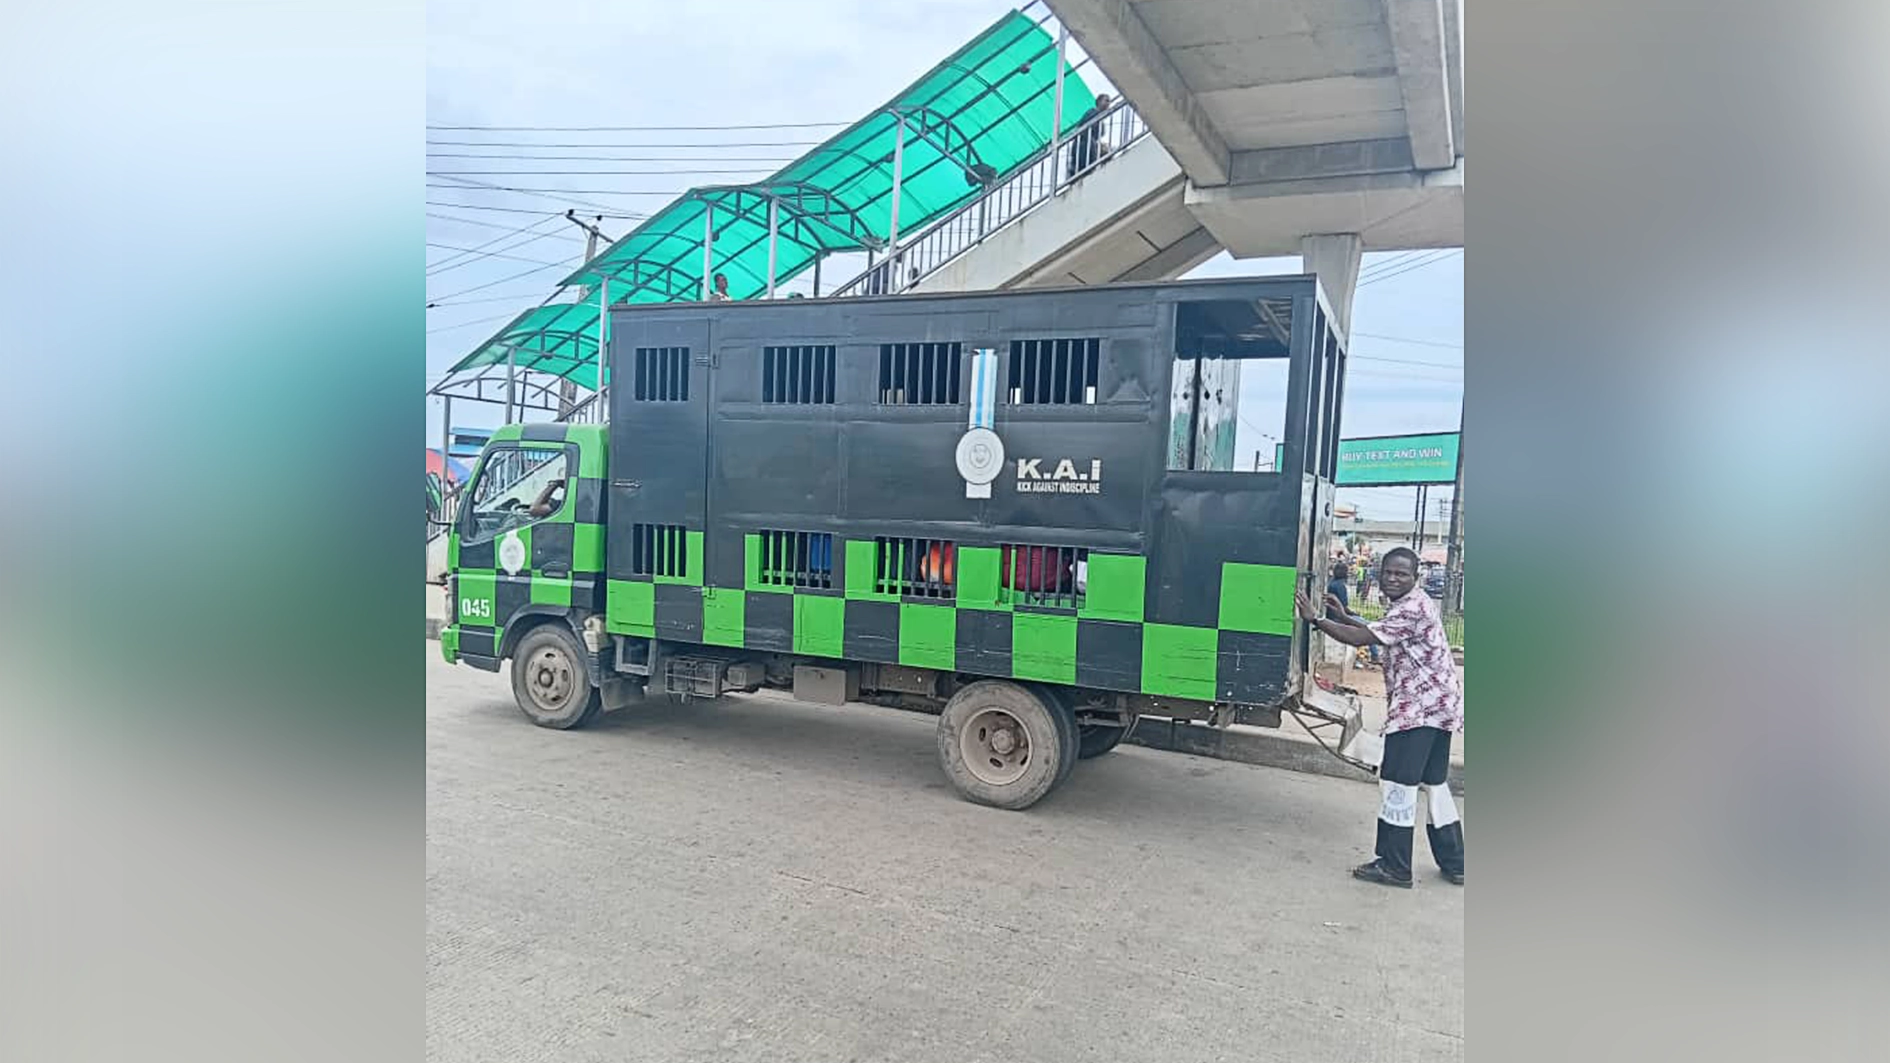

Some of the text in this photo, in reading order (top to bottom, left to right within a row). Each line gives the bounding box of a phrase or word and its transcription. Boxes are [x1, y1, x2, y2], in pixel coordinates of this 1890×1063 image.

[1393, 448, 1417, 459] AND
[1418, 447, 1442, 458] WIN
[1017, 481, 1100, 494] KICK AGAINST INDISCIPLINE
[462, 598, 490, 617] 045
